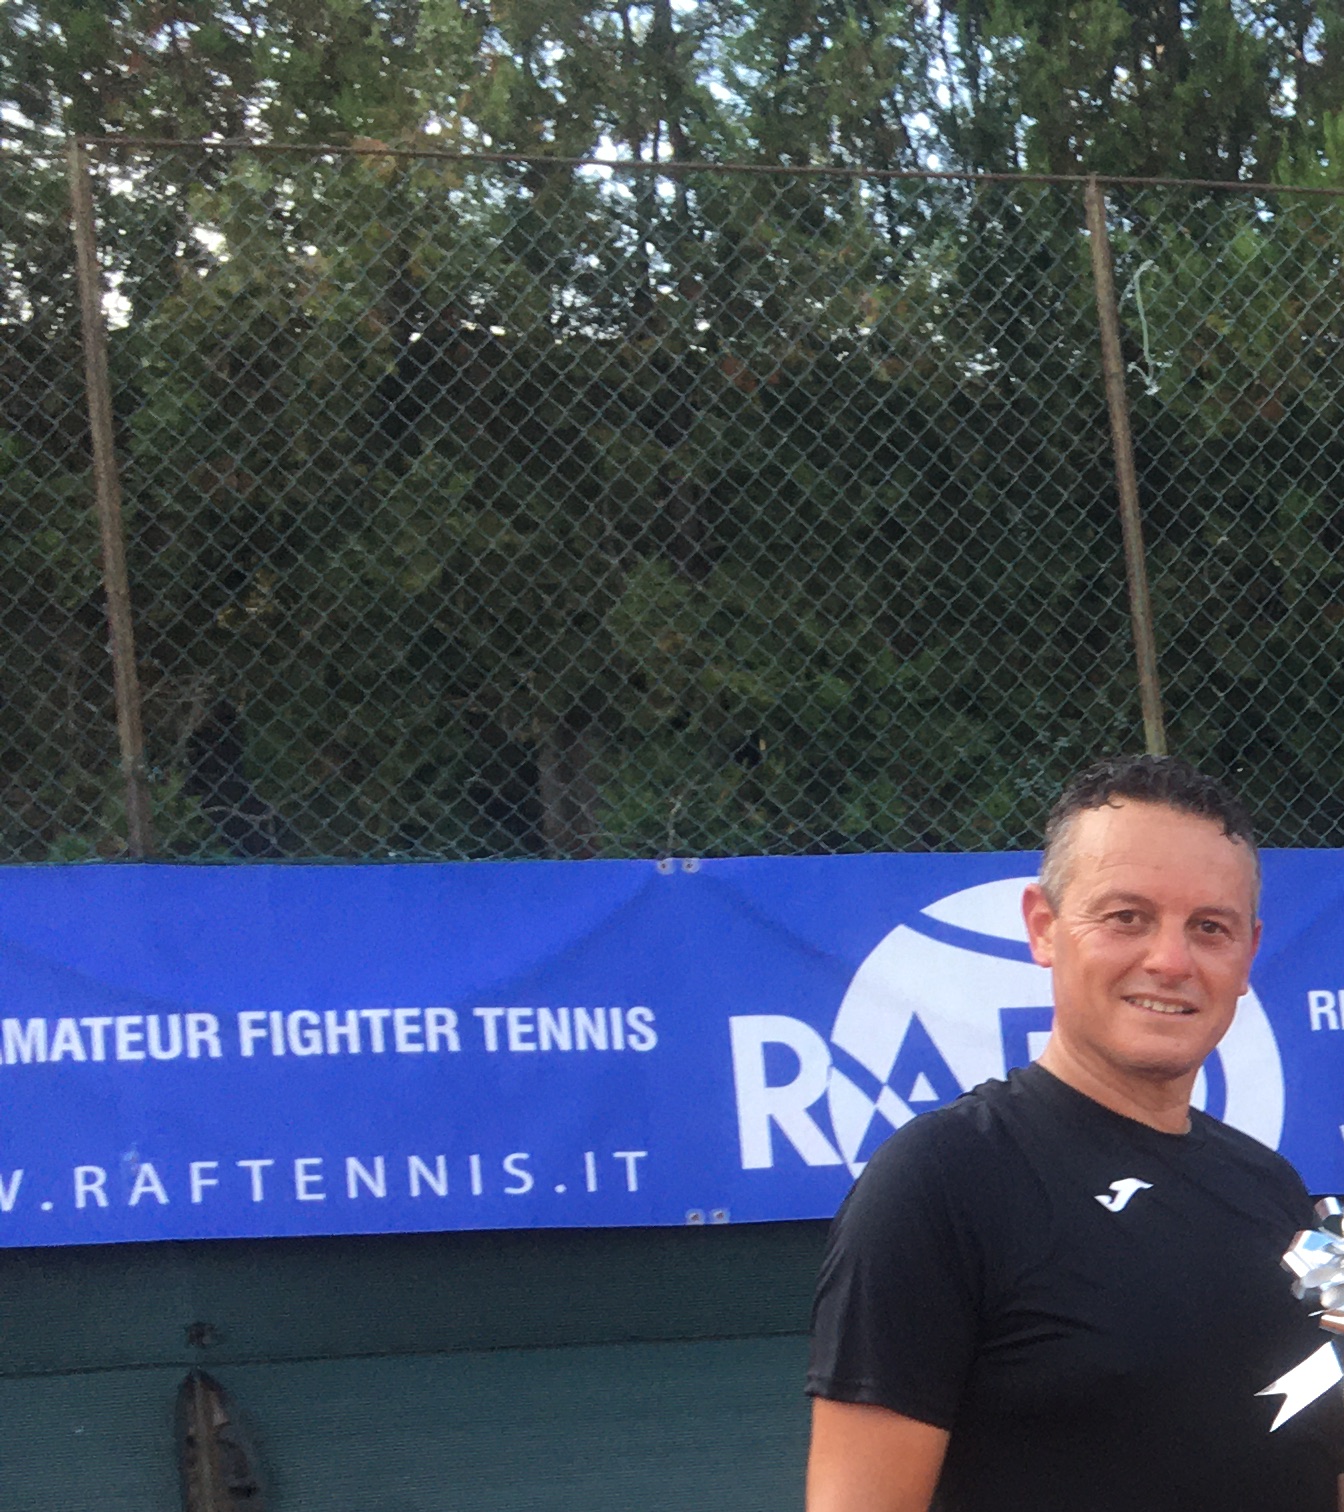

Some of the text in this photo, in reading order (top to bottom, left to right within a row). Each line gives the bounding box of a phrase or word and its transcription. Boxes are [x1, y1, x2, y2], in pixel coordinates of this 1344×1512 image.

[0, 1006, 659, 1066] MATEUR FIGHTER TENNIS
